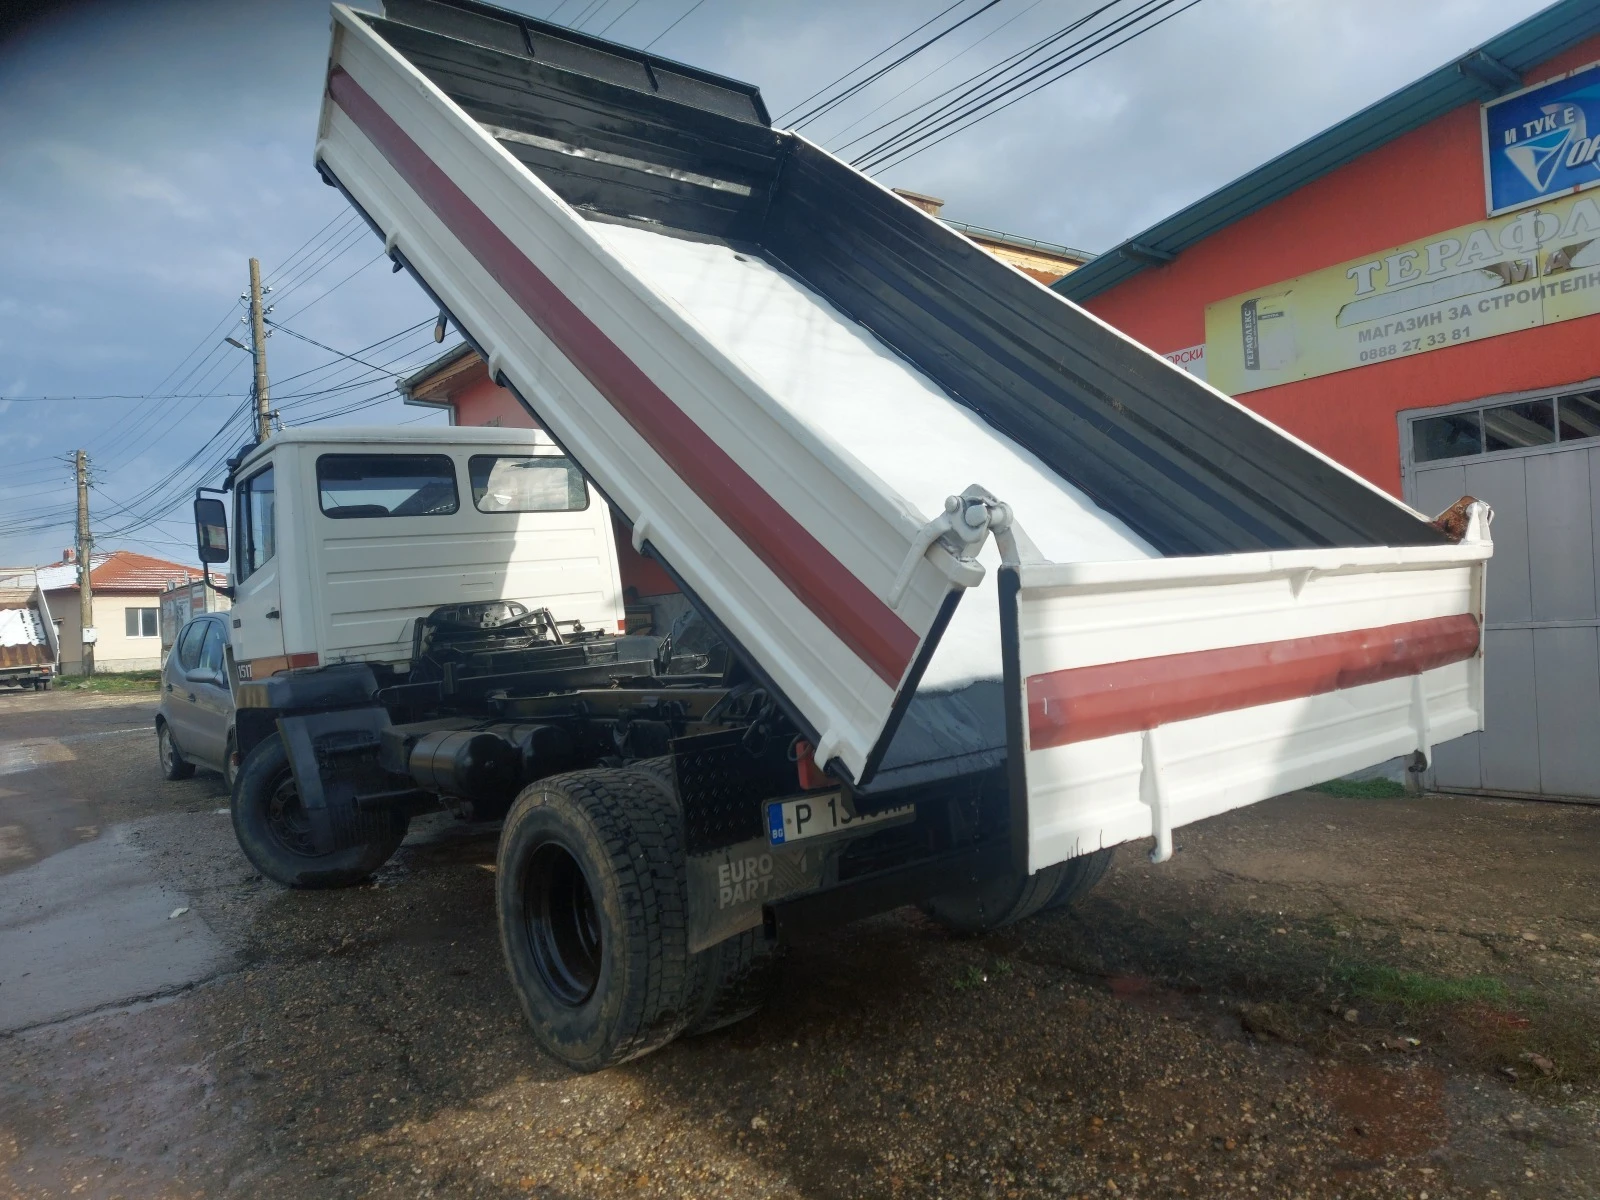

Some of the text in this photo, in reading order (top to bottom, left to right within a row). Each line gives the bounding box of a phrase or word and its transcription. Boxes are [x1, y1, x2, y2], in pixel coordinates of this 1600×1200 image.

[1505, 106, 1575, 145] И ТУК Е
[1358, 269, 1600, 343] МАГАЗИН ЗА СТРОИТЕЛН
[1244, 309, 1255, 367] ТЕРАФЛЕКС
[1359, 326, 1471, 362] 0888 27 33 81
[772, 828, 783, 839] BG
[718, 853, 774, 887] EURO
[719, 874, 774, 909] PART
